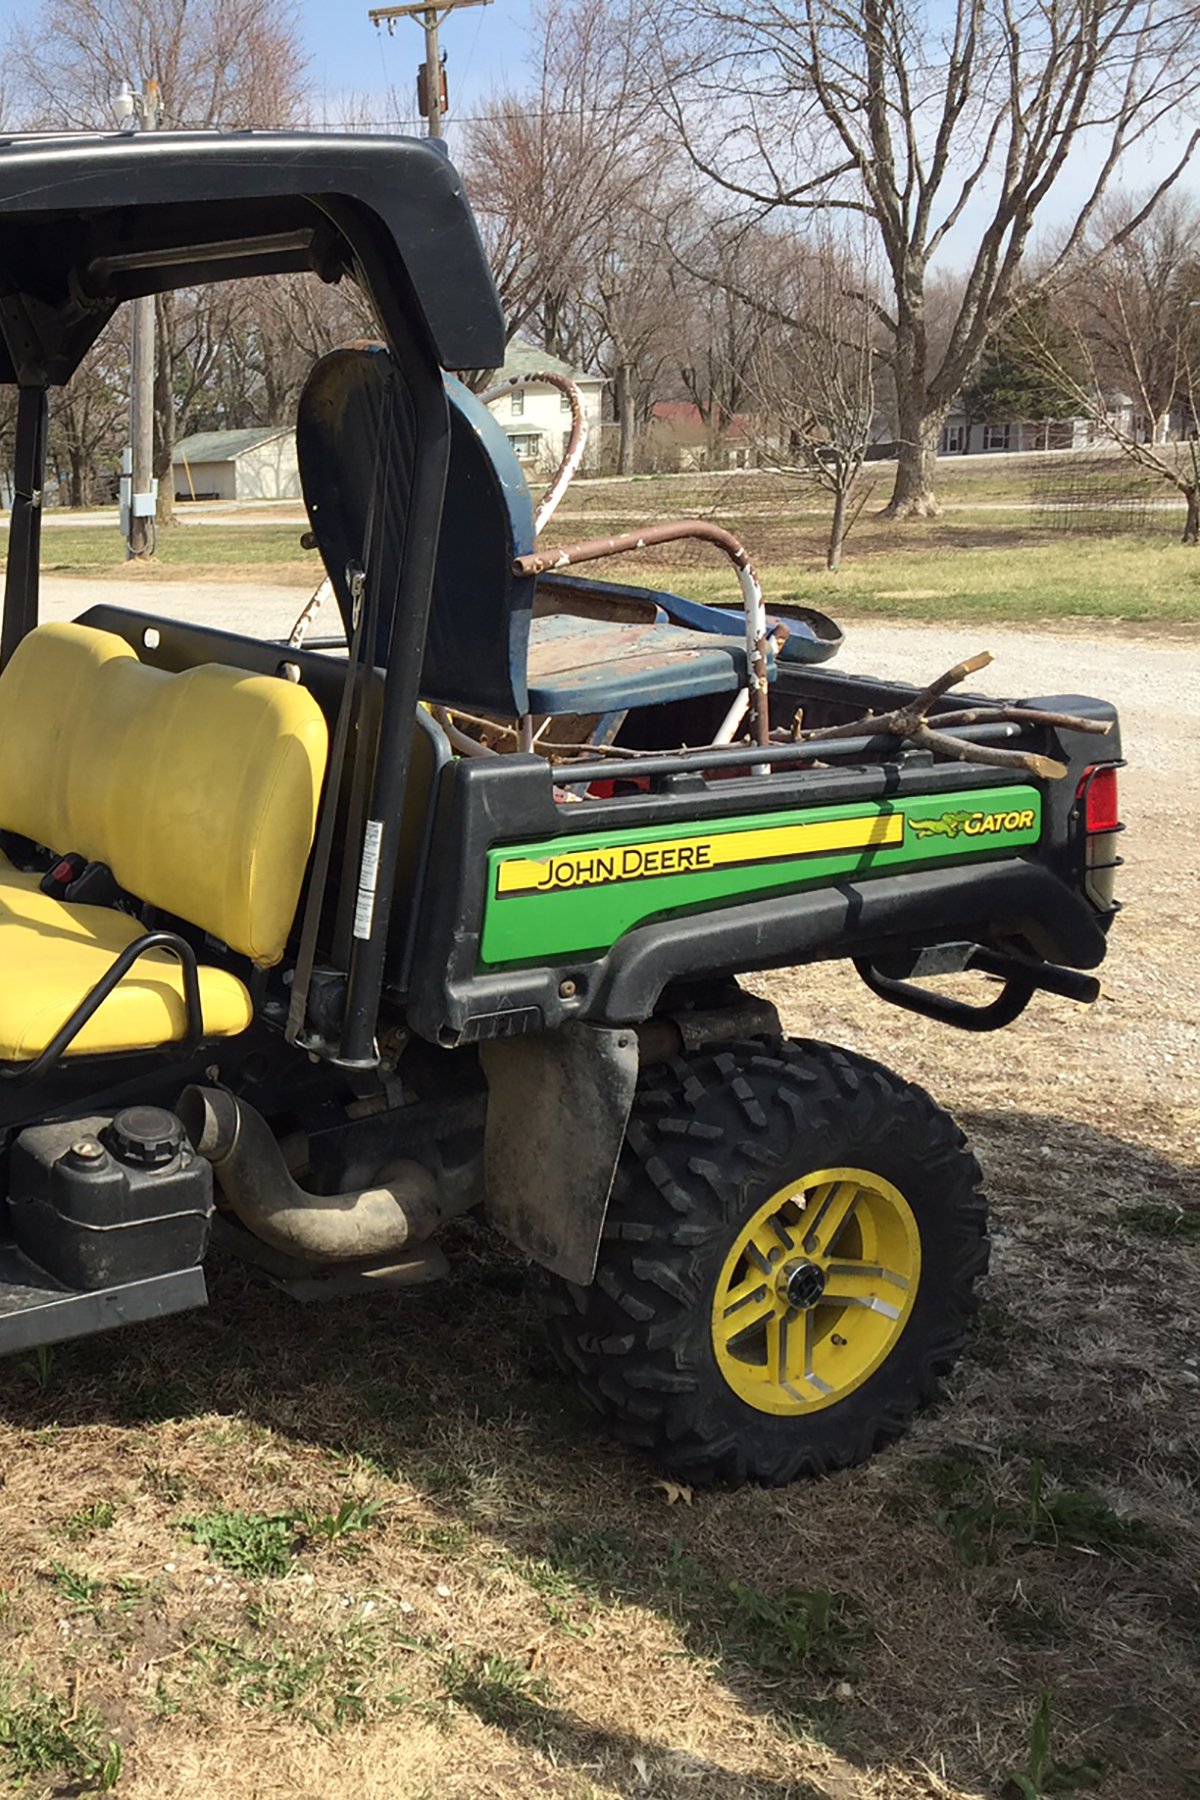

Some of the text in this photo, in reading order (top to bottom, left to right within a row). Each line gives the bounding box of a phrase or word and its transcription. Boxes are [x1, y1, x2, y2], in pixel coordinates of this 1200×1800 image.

[963, 809, 1035, 836] GATOR
[537, 844, 711, 886] JOHN DEERE
